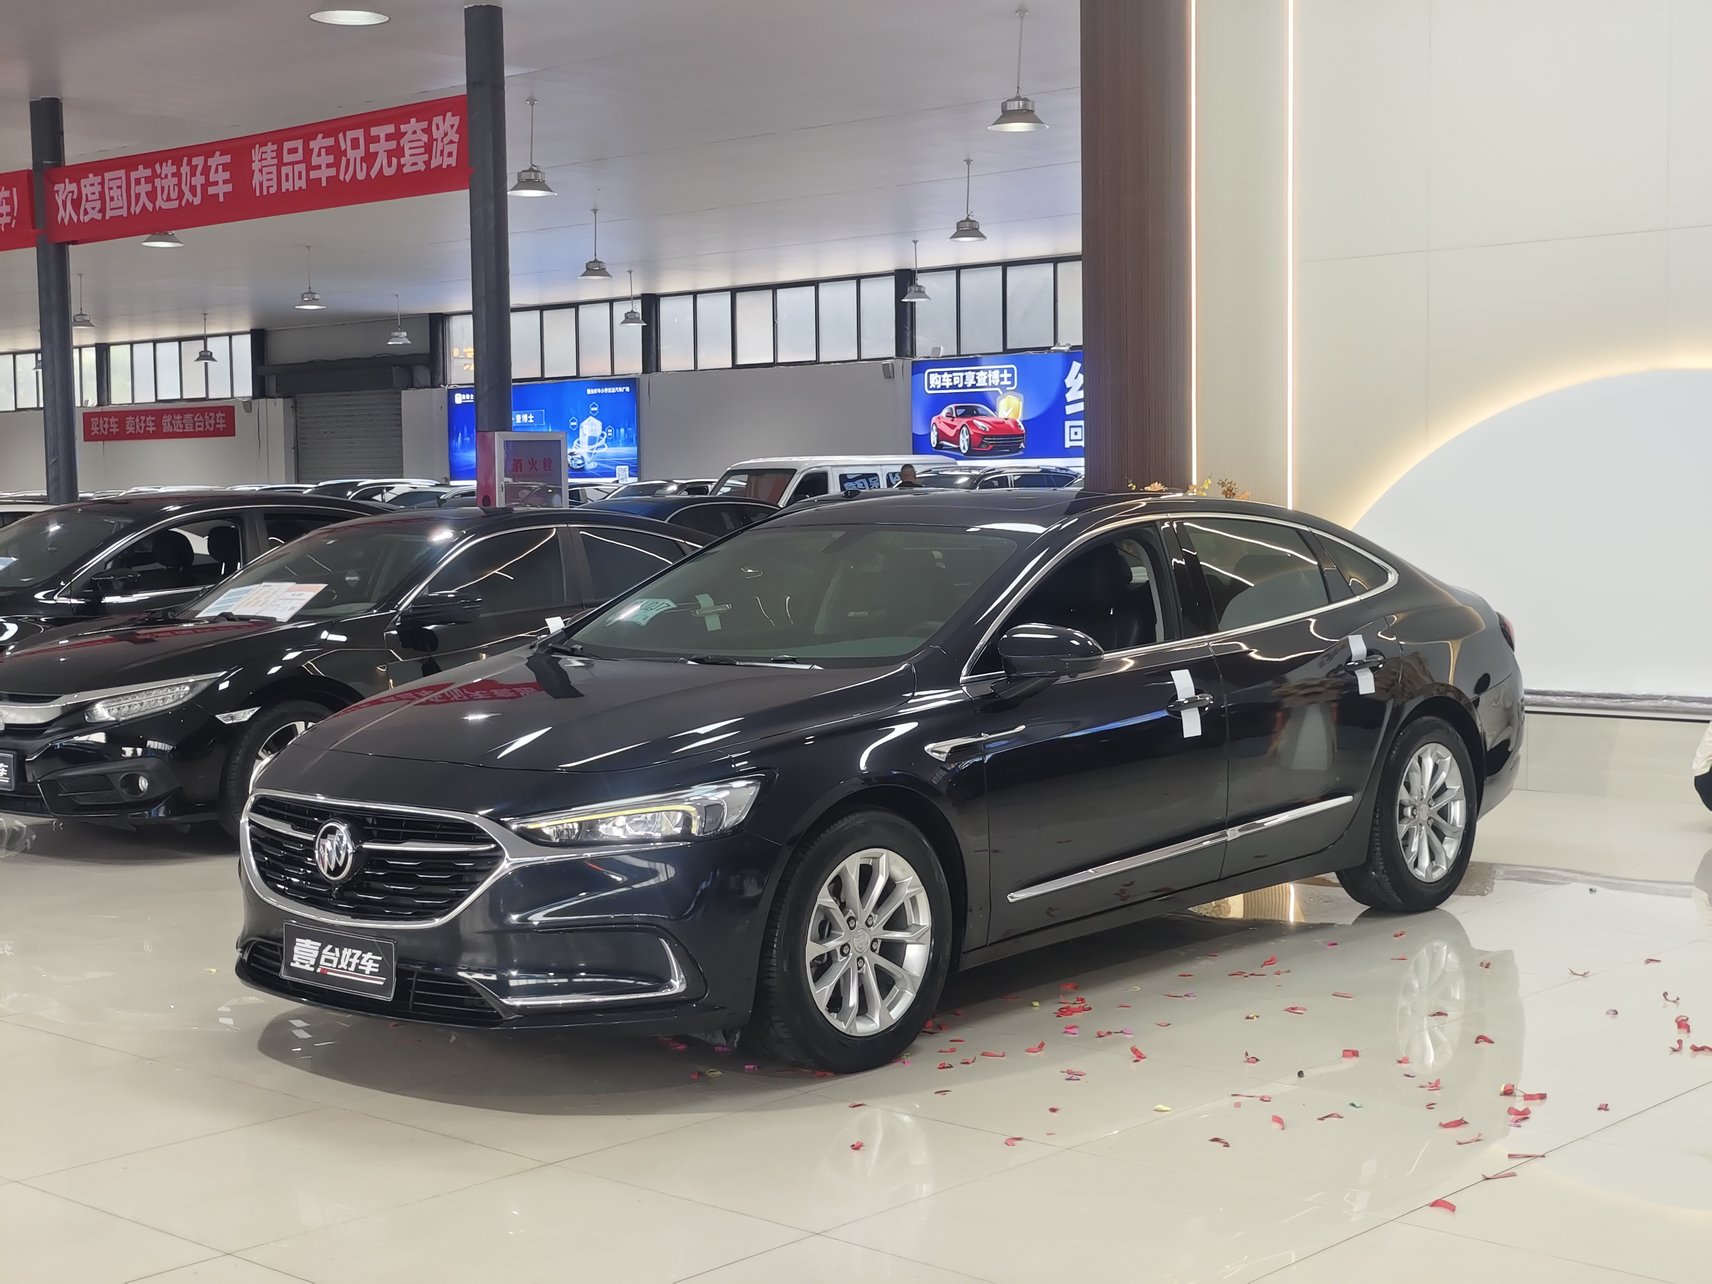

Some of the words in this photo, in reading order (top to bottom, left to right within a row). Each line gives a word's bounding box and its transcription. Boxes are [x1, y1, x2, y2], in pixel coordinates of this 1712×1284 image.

[53, 151, 233, 227] 欢度国庆选好车
[250, 112, 462, 197] 精品车况无套路
[929, 369, 1012, 389] 购车可享查博士
[90, 416, 120, 436] 买好车
[125, 415, 156, 434] 卖好车
[162, 412, 226, 433] 就选壹台好车
[290, 938, 382, 975] 壹台好车
